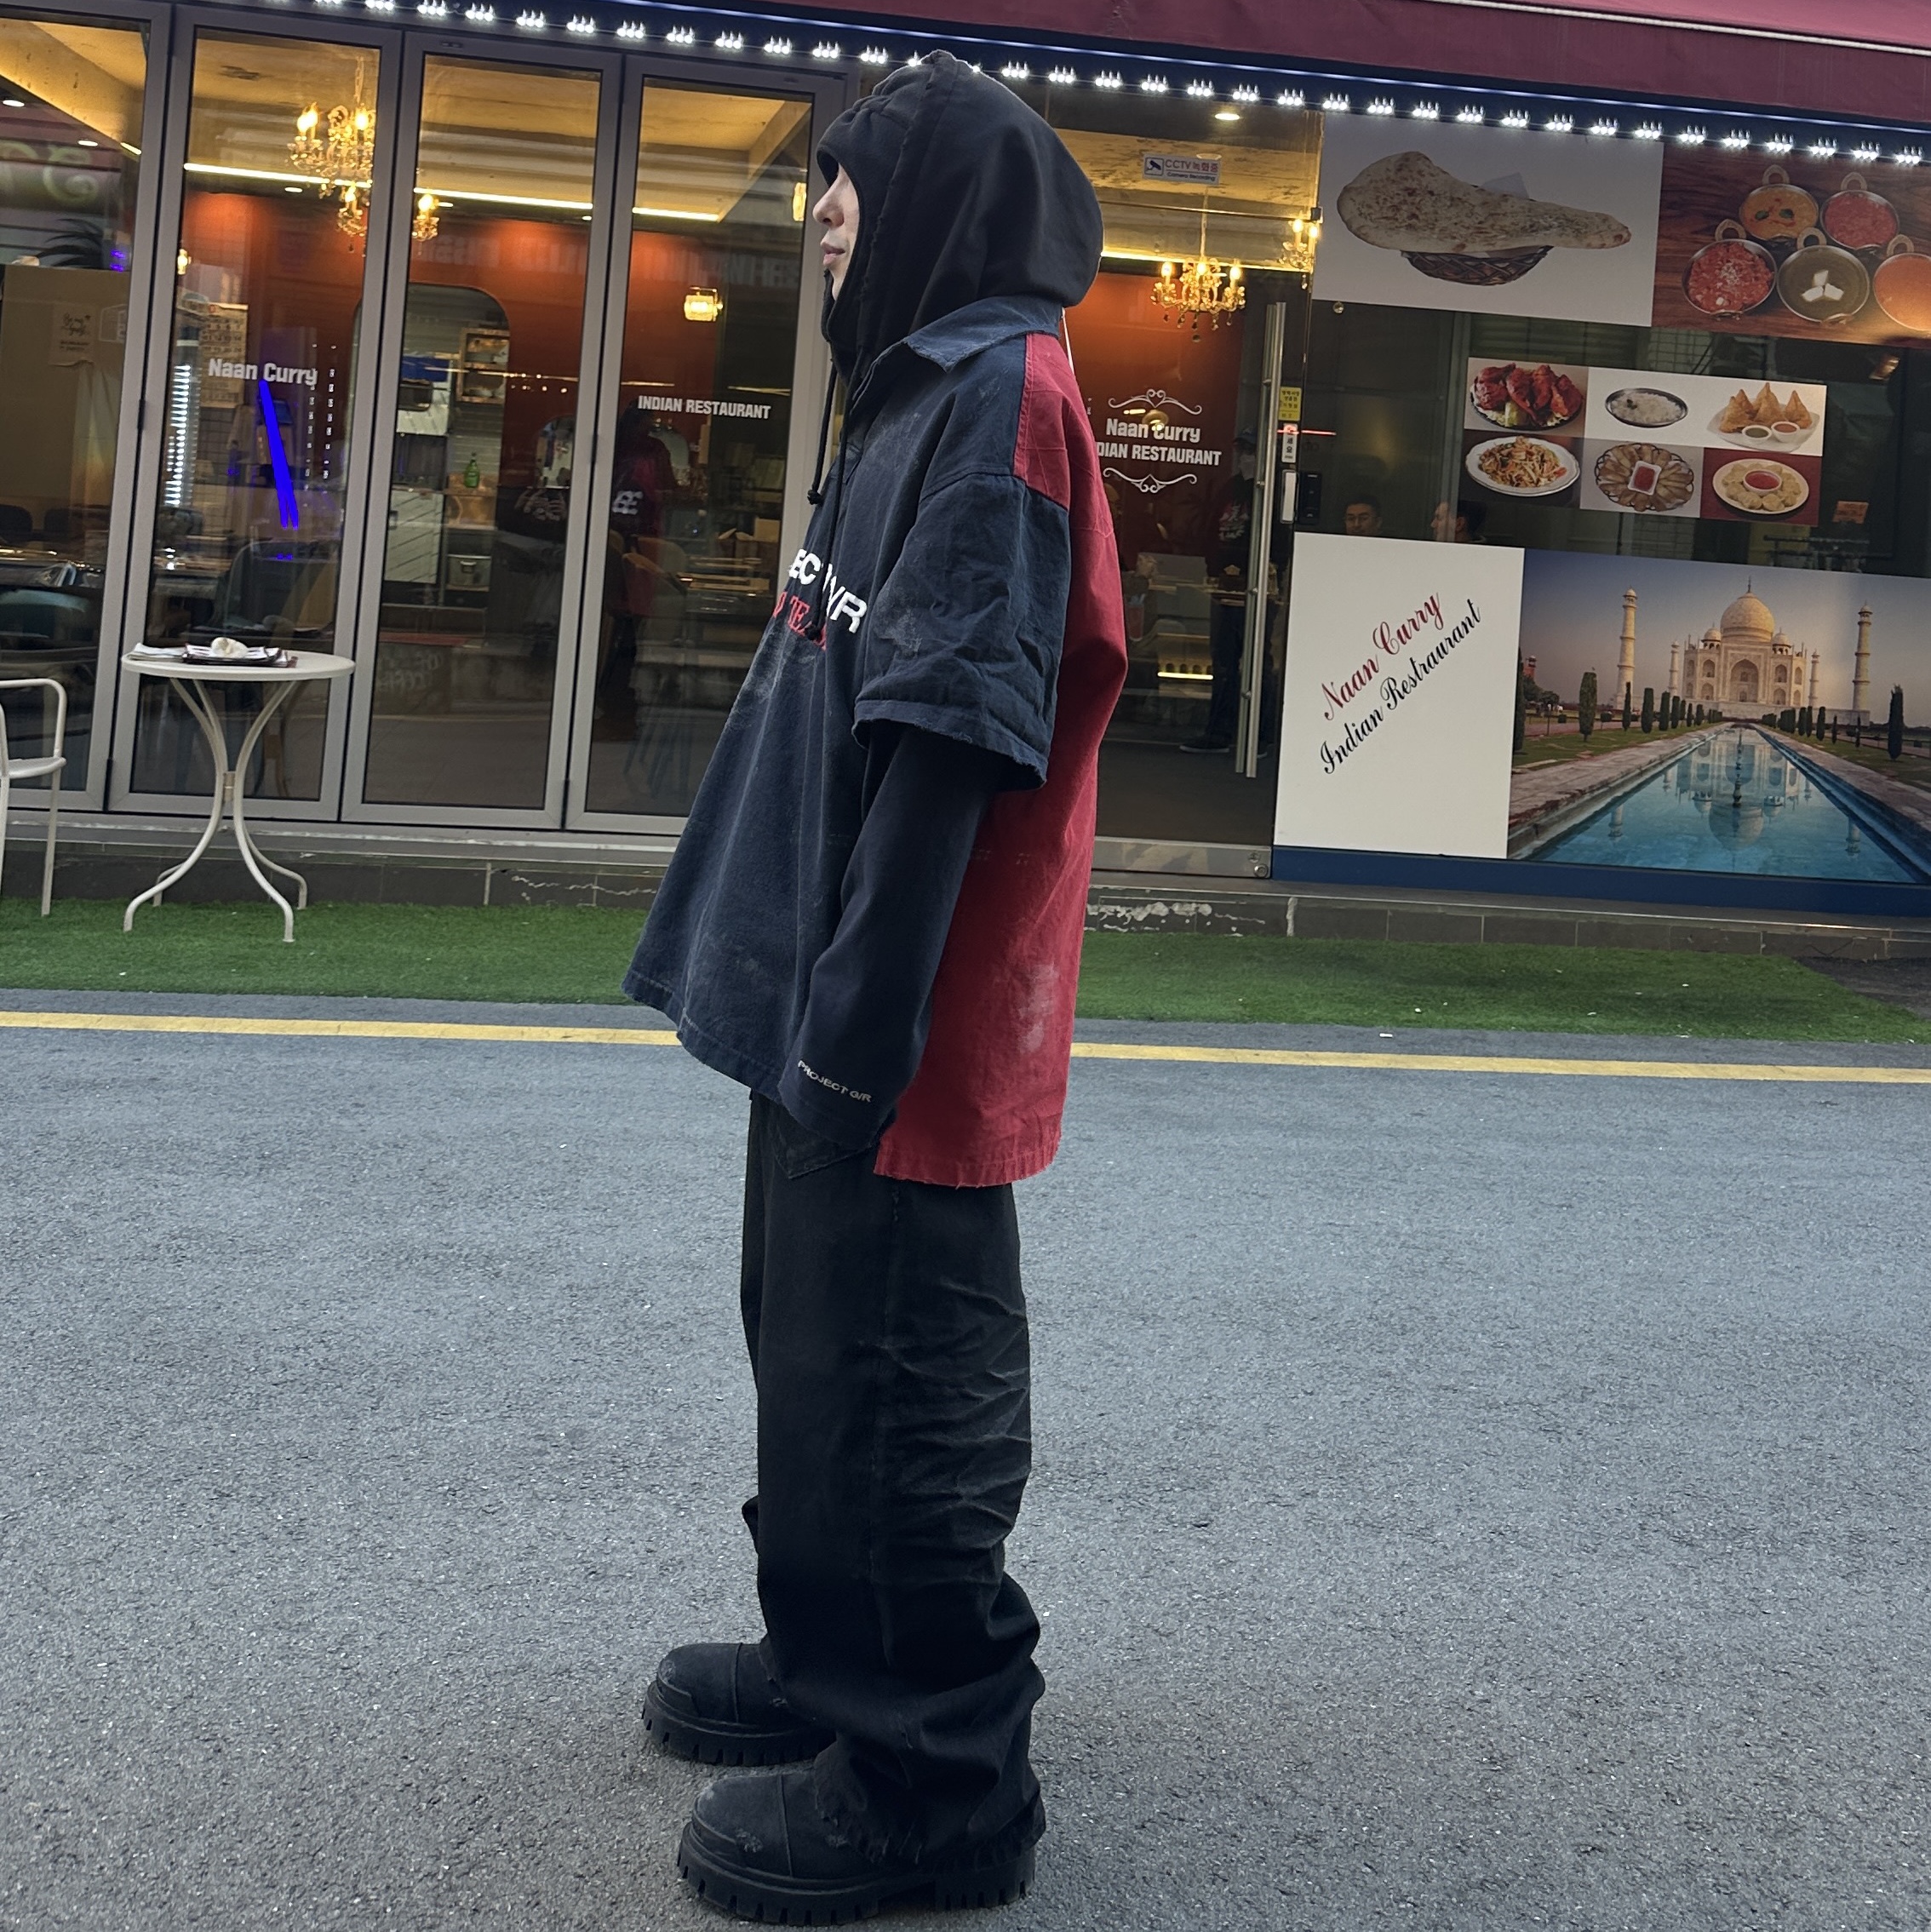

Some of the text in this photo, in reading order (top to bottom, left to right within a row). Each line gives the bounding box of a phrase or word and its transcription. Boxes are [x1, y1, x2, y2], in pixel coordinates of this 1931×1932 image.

[1165, 158, 1191, 169] CCTV
[208, 358, 318, 387] Naan Curry
[638, 395, 771, 419] INDIAN RESTAURANT
[1106, 418, 1149, 439] Naan
[1096, 441, 1223, 466] DIAN RESTAURANT
[1321, 592, 1444, 721] Naan Curry
[1321, 598, 1481, 775] Indian Restraurant
[798, 1059, 849, 1094] PROJECT
